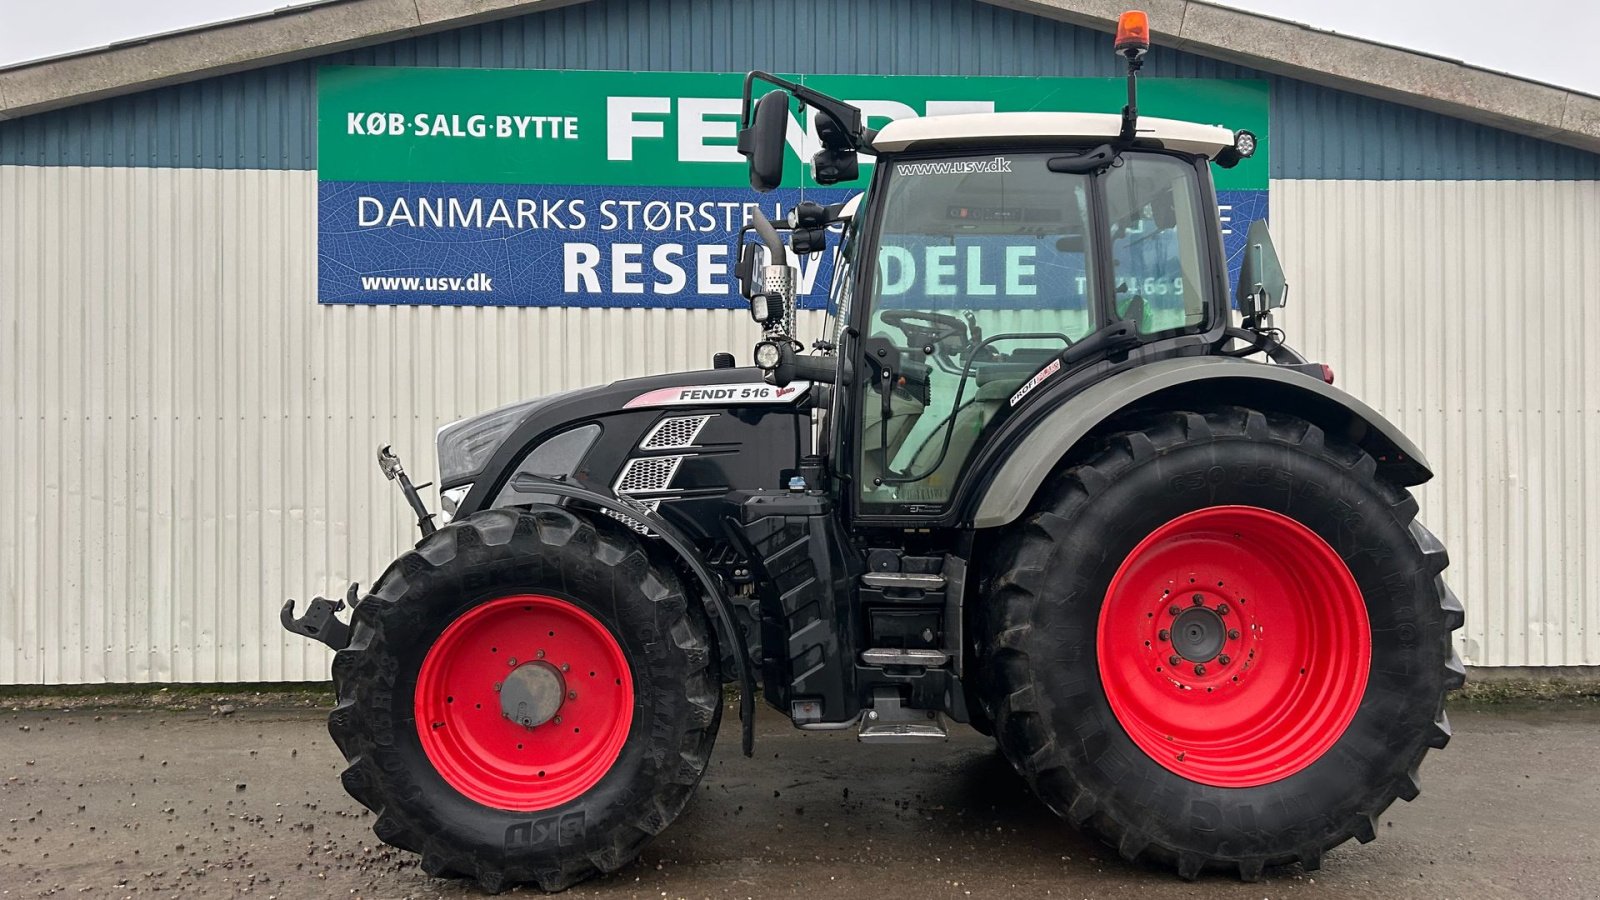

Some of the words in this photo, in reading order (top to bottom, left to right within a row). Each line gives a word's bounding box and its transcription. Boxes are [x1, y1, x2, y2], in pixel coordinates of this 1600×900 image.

[898, 157, 1012, 175] www.usv.dk
[358, 196, 587, 230] DANMARKS
[564, 242, 1038, 296] RESEVDELE
[362, 273, 493, 292] www.usv.dk
[680, 388, 737, 400] FENDT
[740, 387, 770, 398] 516
[504, 810, 586, 852] BKT
